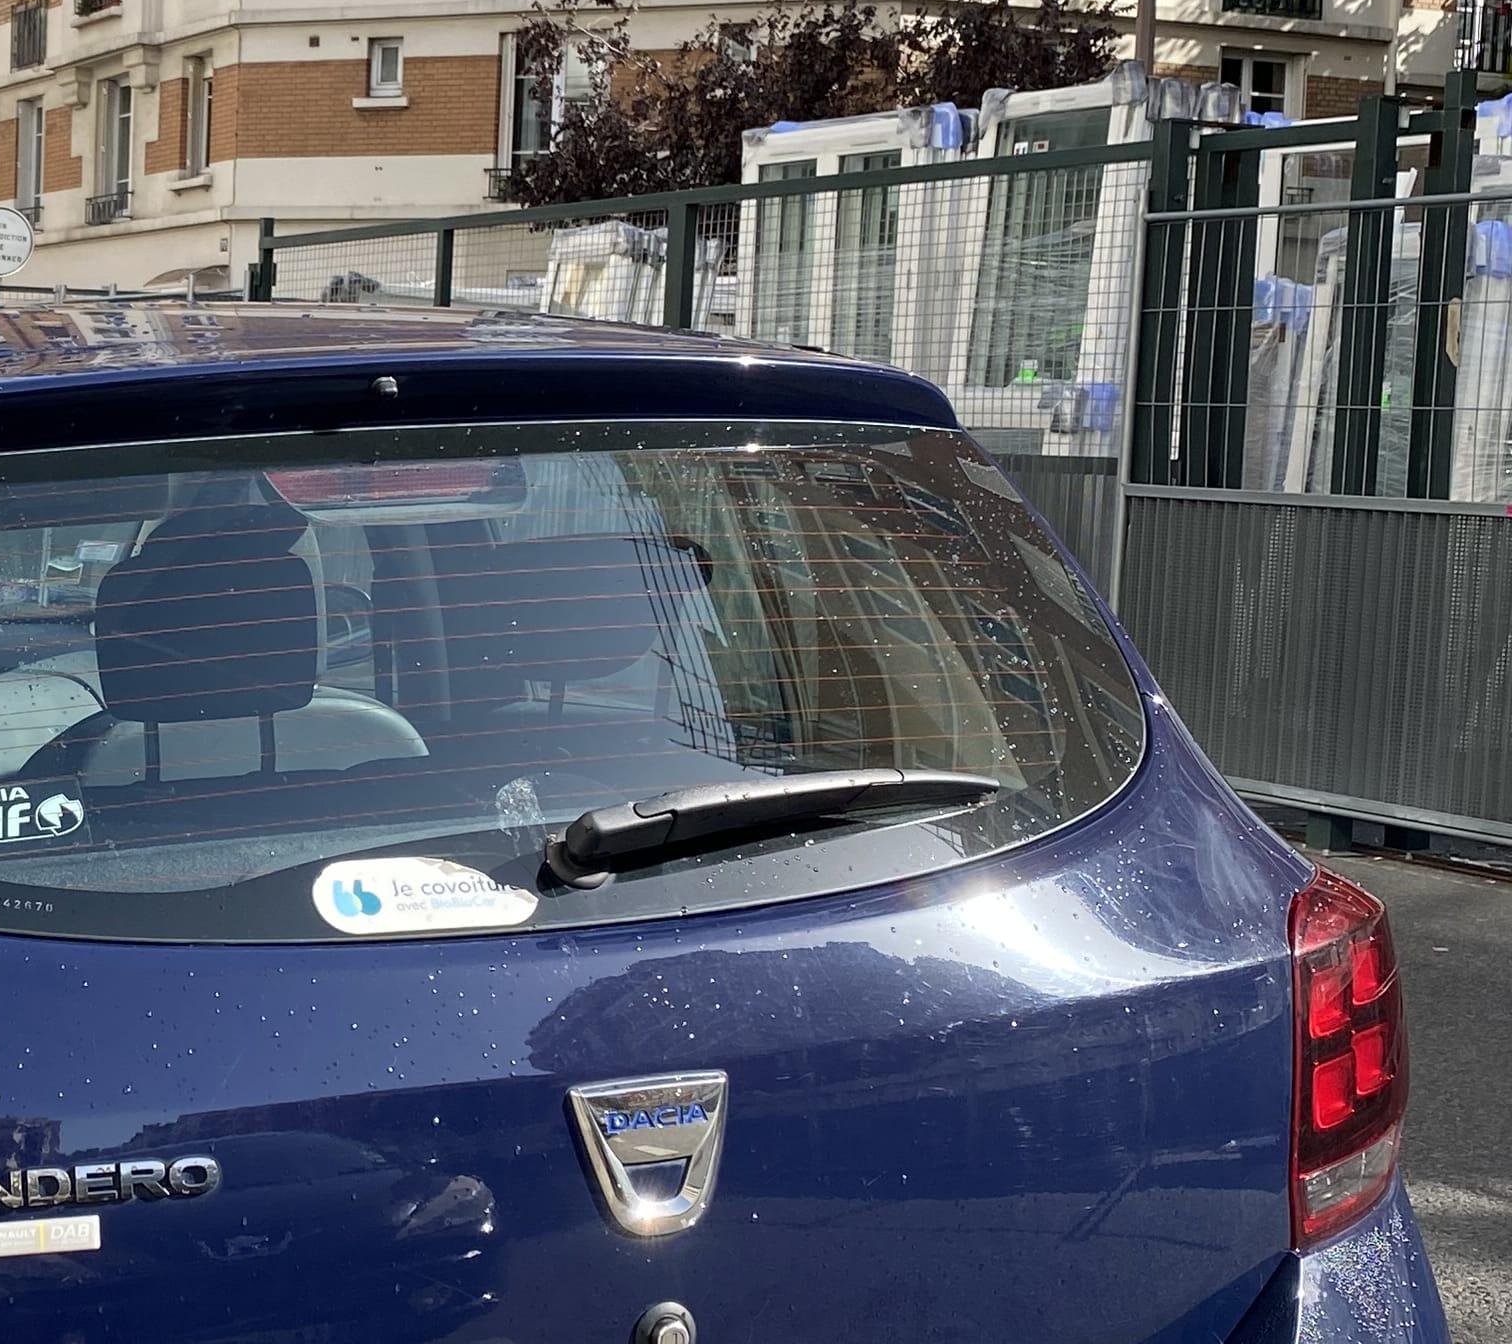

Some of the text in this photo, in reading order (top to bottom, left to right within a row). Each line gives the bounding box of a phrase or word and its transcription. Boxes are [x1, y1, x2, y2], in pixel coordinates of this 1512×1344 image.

[392, 879, 414, 897] Je
[396, 902, 426, 912] avec
[606, 1103, 709, 1135] DACIA
